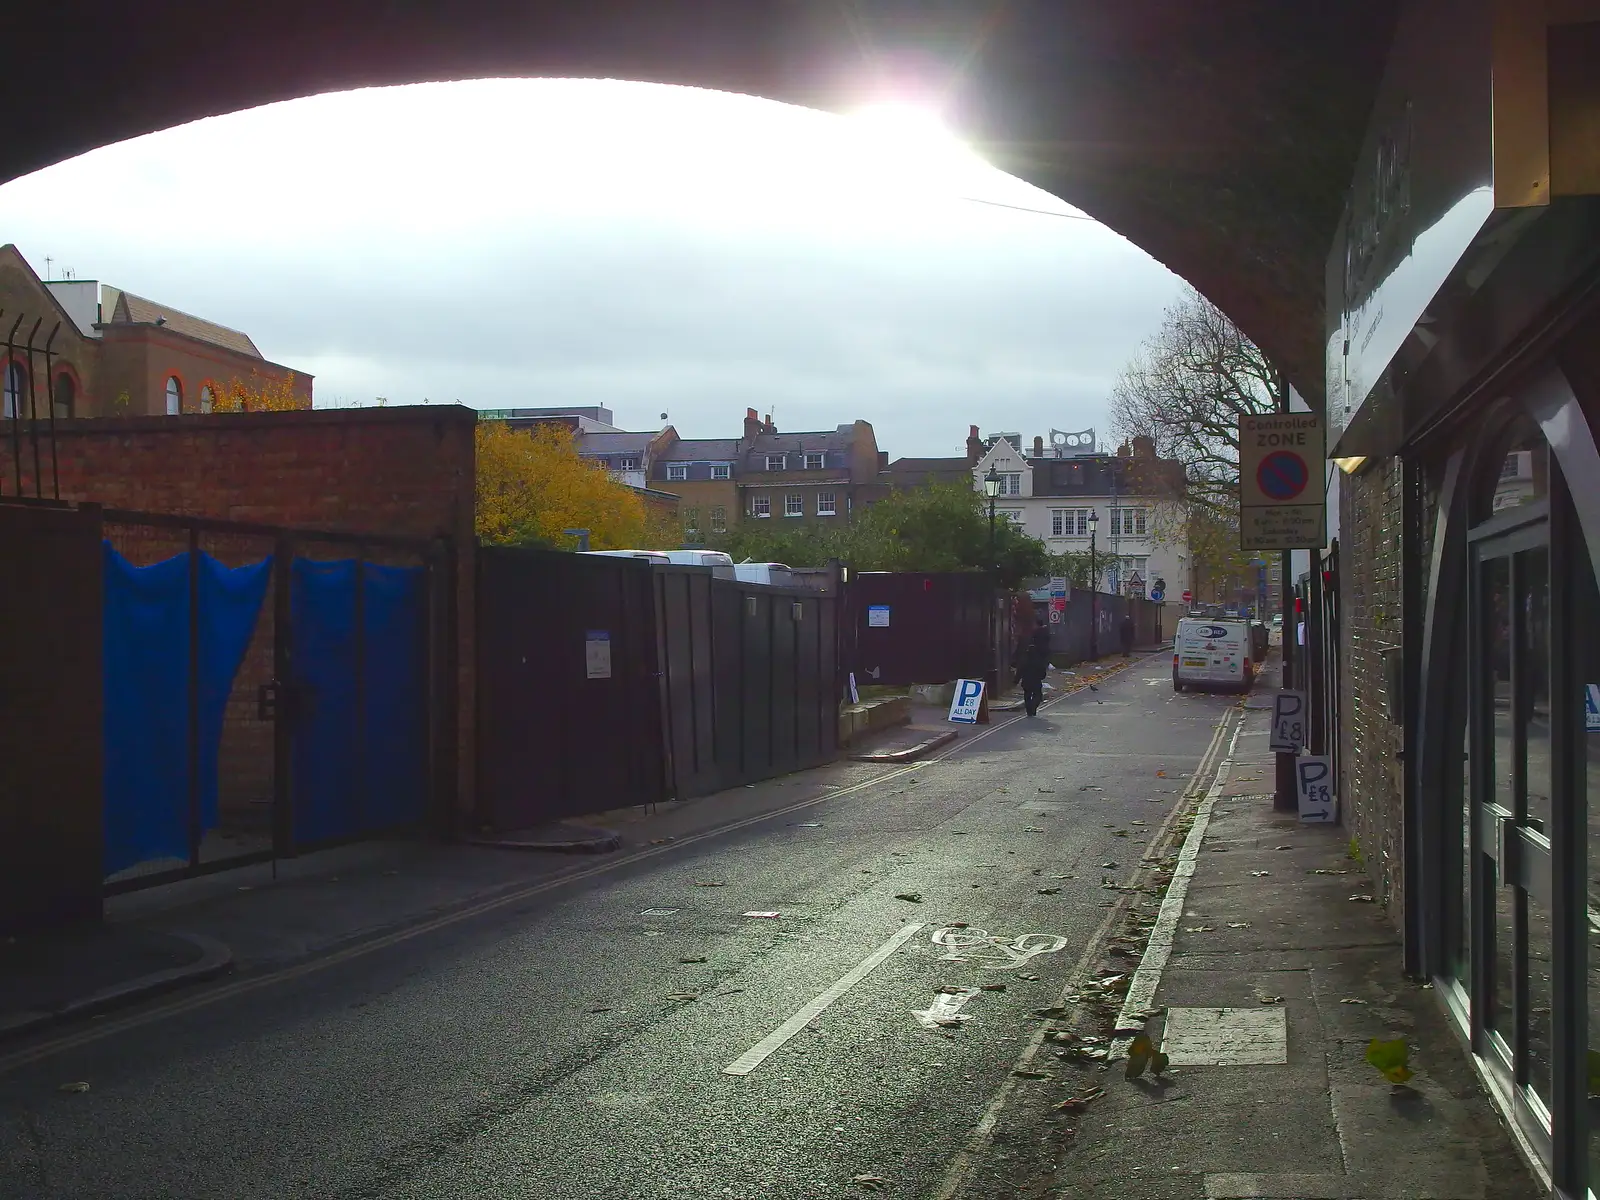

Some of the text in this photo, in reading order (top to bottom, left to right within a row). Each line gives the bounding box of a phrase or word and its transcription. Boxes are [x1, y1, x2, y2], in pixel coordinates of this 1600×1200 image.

[1247, 418, 1317, 430] Controlled
[1257, 432, 1306, 447] ZONE
[958, 680, 982, 707] P
[965, 698, 975, 707] £8
[964, 708, 977, 716] DAY
[1275, 694, 1302, 729] P
[1279, 720, 1302, 741] £8
[1299, 762, 1328, 795] P
[1308, 785, 1331, 802] £8
